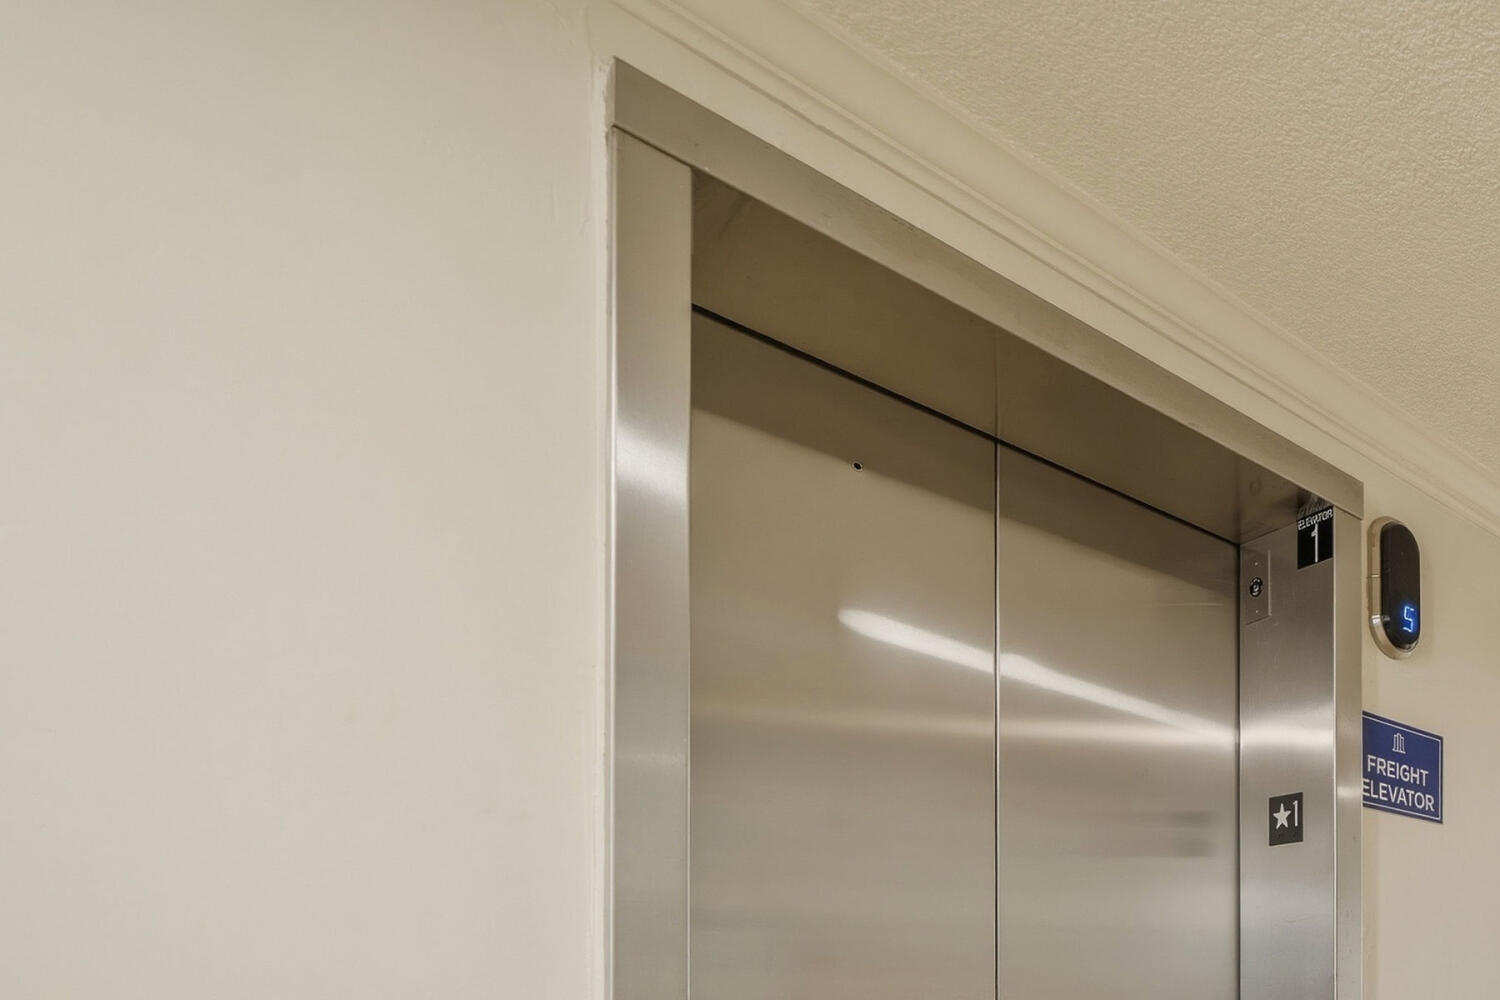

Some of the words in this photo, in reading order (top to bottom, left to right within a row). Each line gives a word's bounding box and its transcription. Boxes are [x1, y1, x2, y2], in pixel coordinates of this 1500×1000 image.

[1310, 523, 1319, 562] 1
[1367, 754, 1429, 787] FREIGHT
[1362, 778, 1435, 812] ELEVATOR
[1292, 799, 1299, 827] 1
